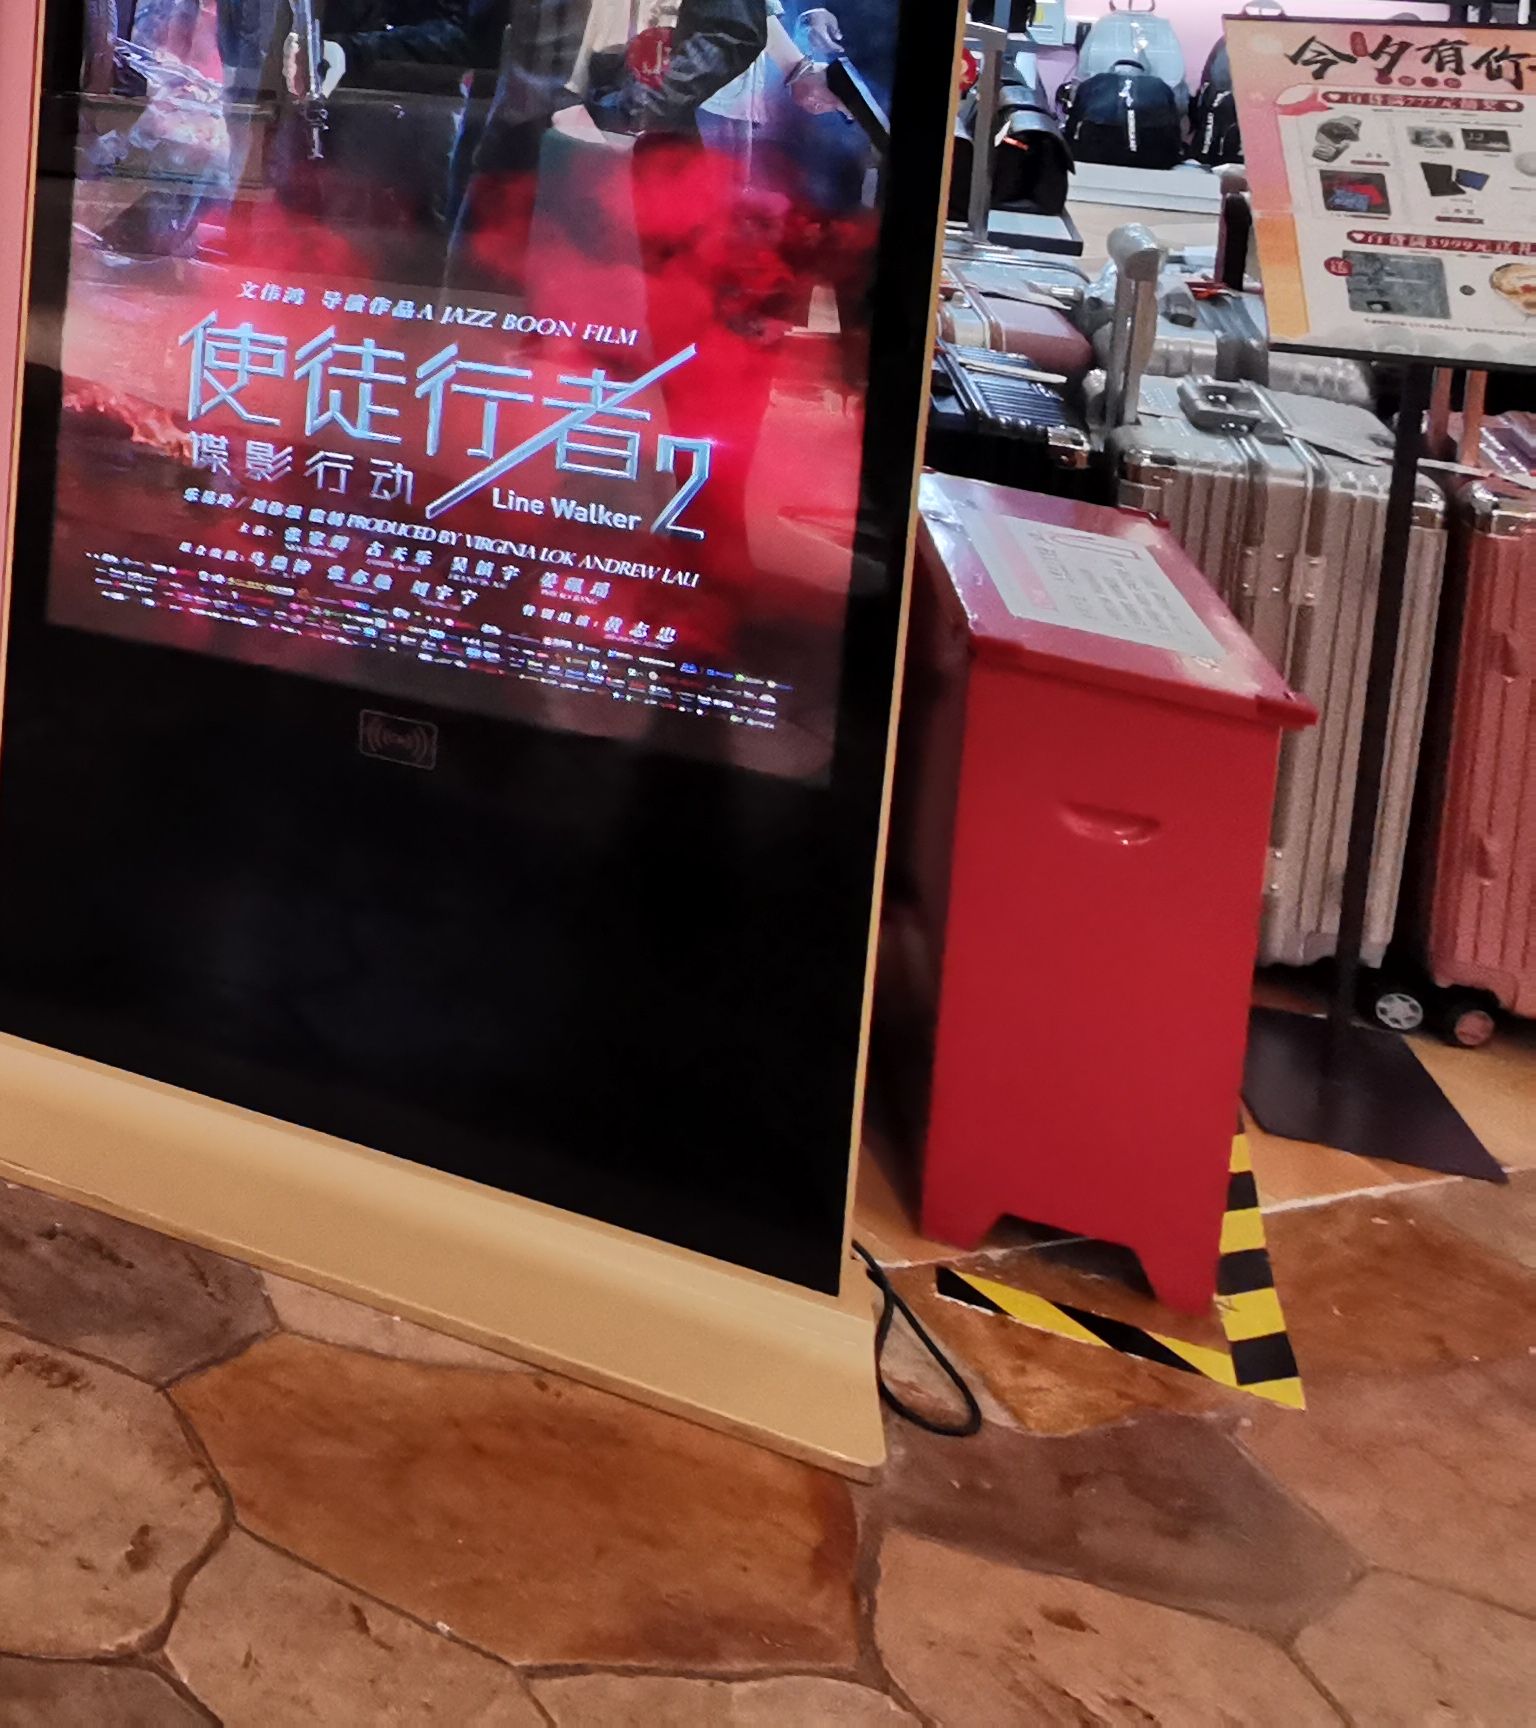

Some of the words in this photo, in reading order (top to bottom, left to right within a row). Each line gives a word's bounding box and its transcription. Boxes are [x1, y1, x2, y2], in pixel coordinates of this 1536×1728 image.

[439, 305, 498, 328] JAZZ
[501, 313, 577, 338] BOON
[582, 323, 638, 347] FILM
[187, 429, 415, 506] 谍影行动
[491, 486, 546, 518] Line
[550, 495, 643, 532] Walker
[437, 529, 462, 546] BY
[465, 533, 537, 560] VIRGINIA
[539, 547, 576, 568] LOK
[577, 553, 661, 582] ANDREW
